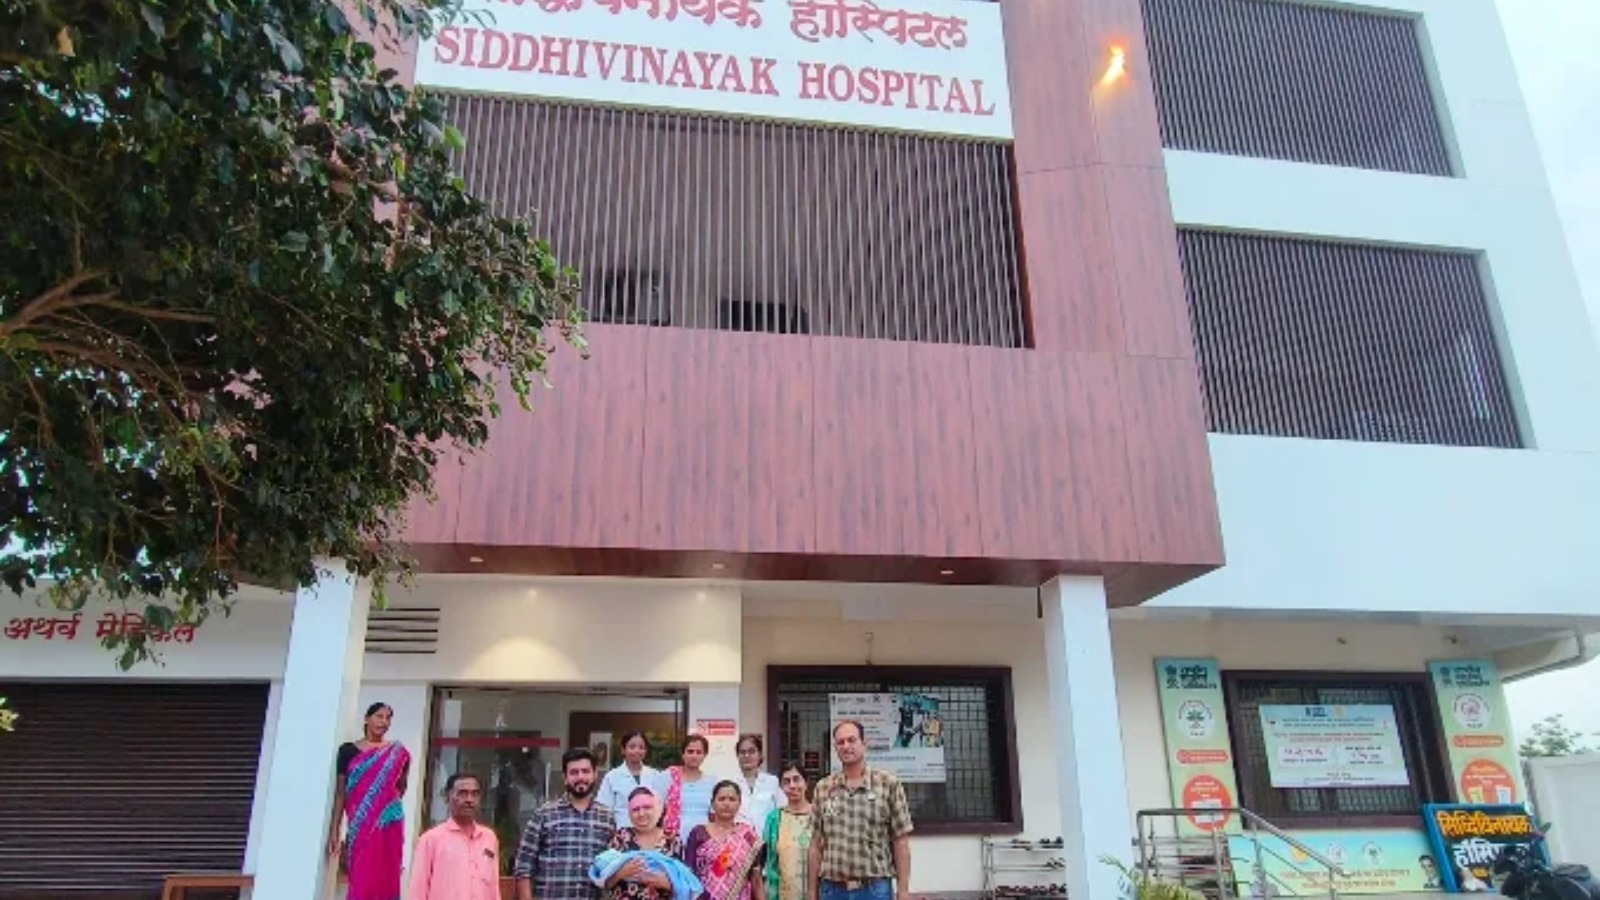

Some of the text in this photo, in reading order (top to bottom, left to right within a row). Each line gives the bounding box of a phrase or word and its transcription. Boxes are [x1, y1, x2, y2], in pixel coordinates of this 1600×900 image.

[435, 26, 996, 117] SIDDHIVINAYAK HOSPITAL
[4, 612, 83, 640] अथर्व
